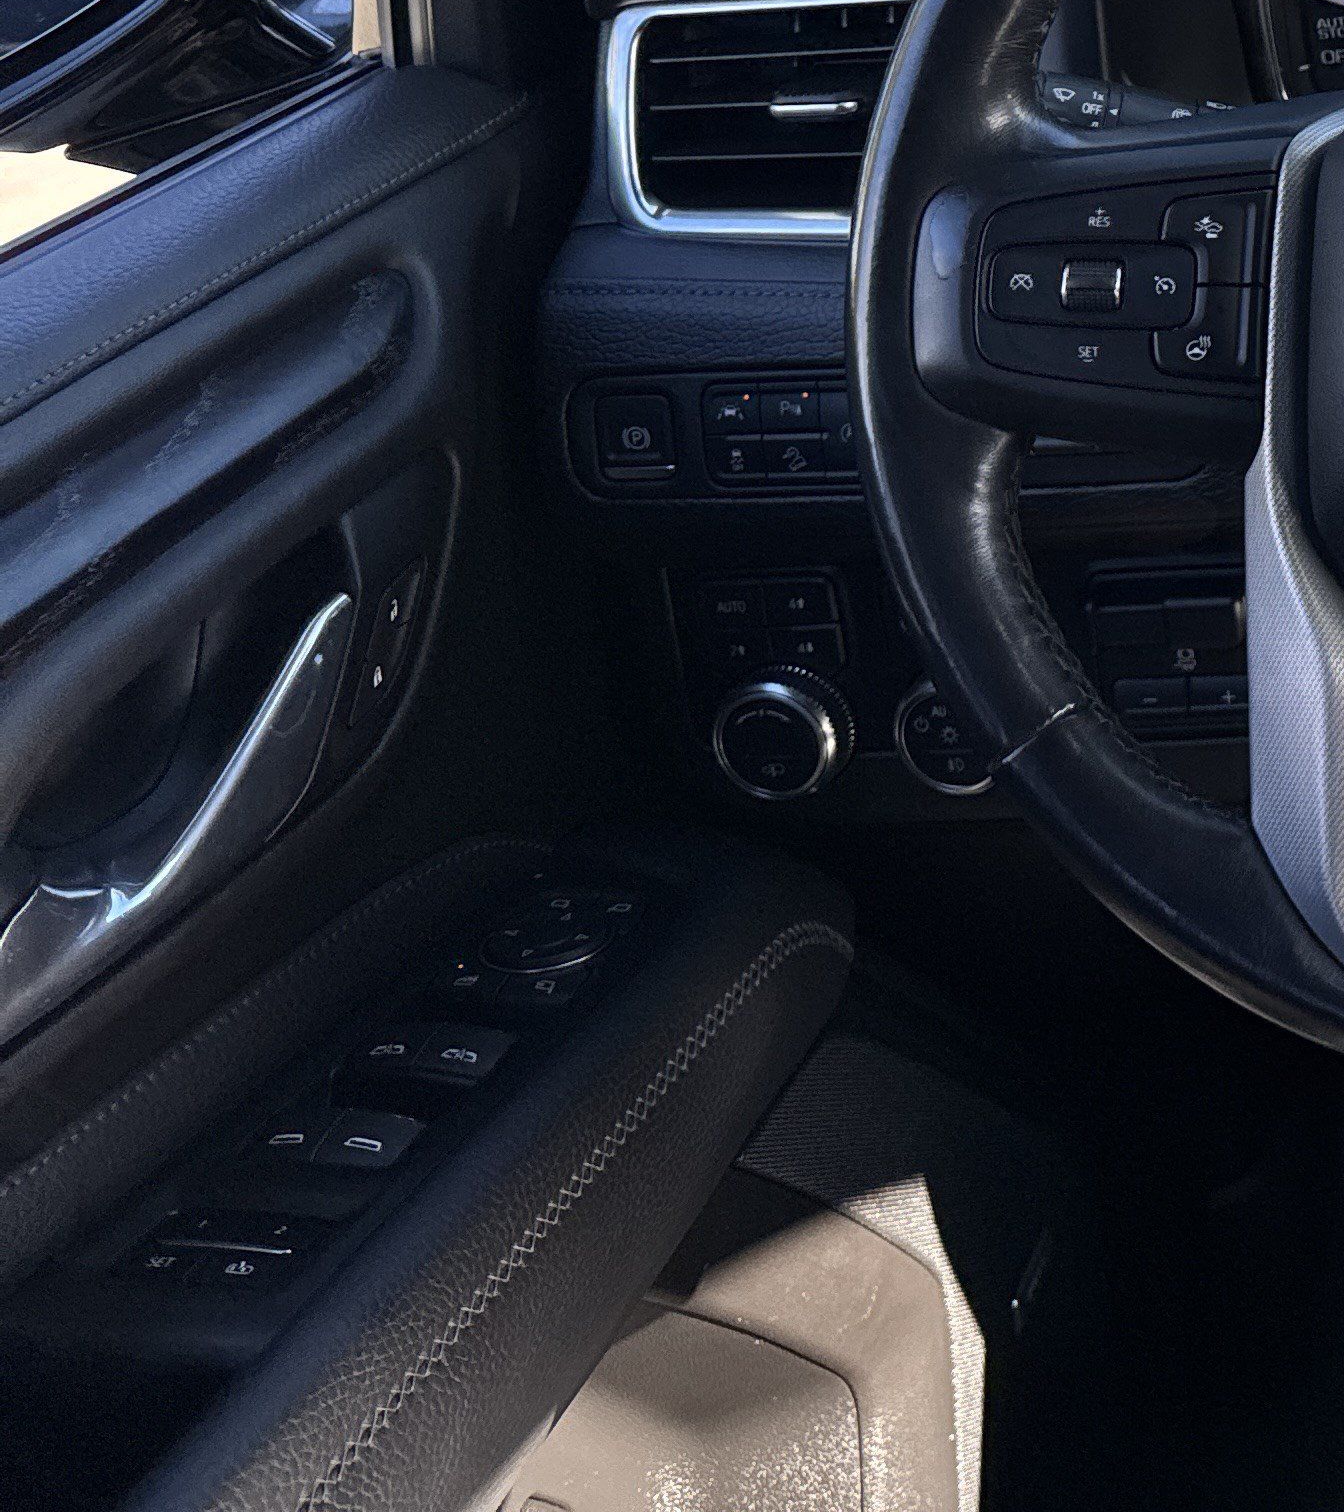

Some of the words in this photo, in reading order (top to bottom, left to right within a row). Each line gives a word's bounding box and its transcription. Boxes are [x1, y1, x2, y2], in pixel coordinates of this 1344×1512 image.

[1081, 102, 1104, 116] OFF
[1087, 215, 1112, 229] RES
[1078, 345, 1100, 359] SET
